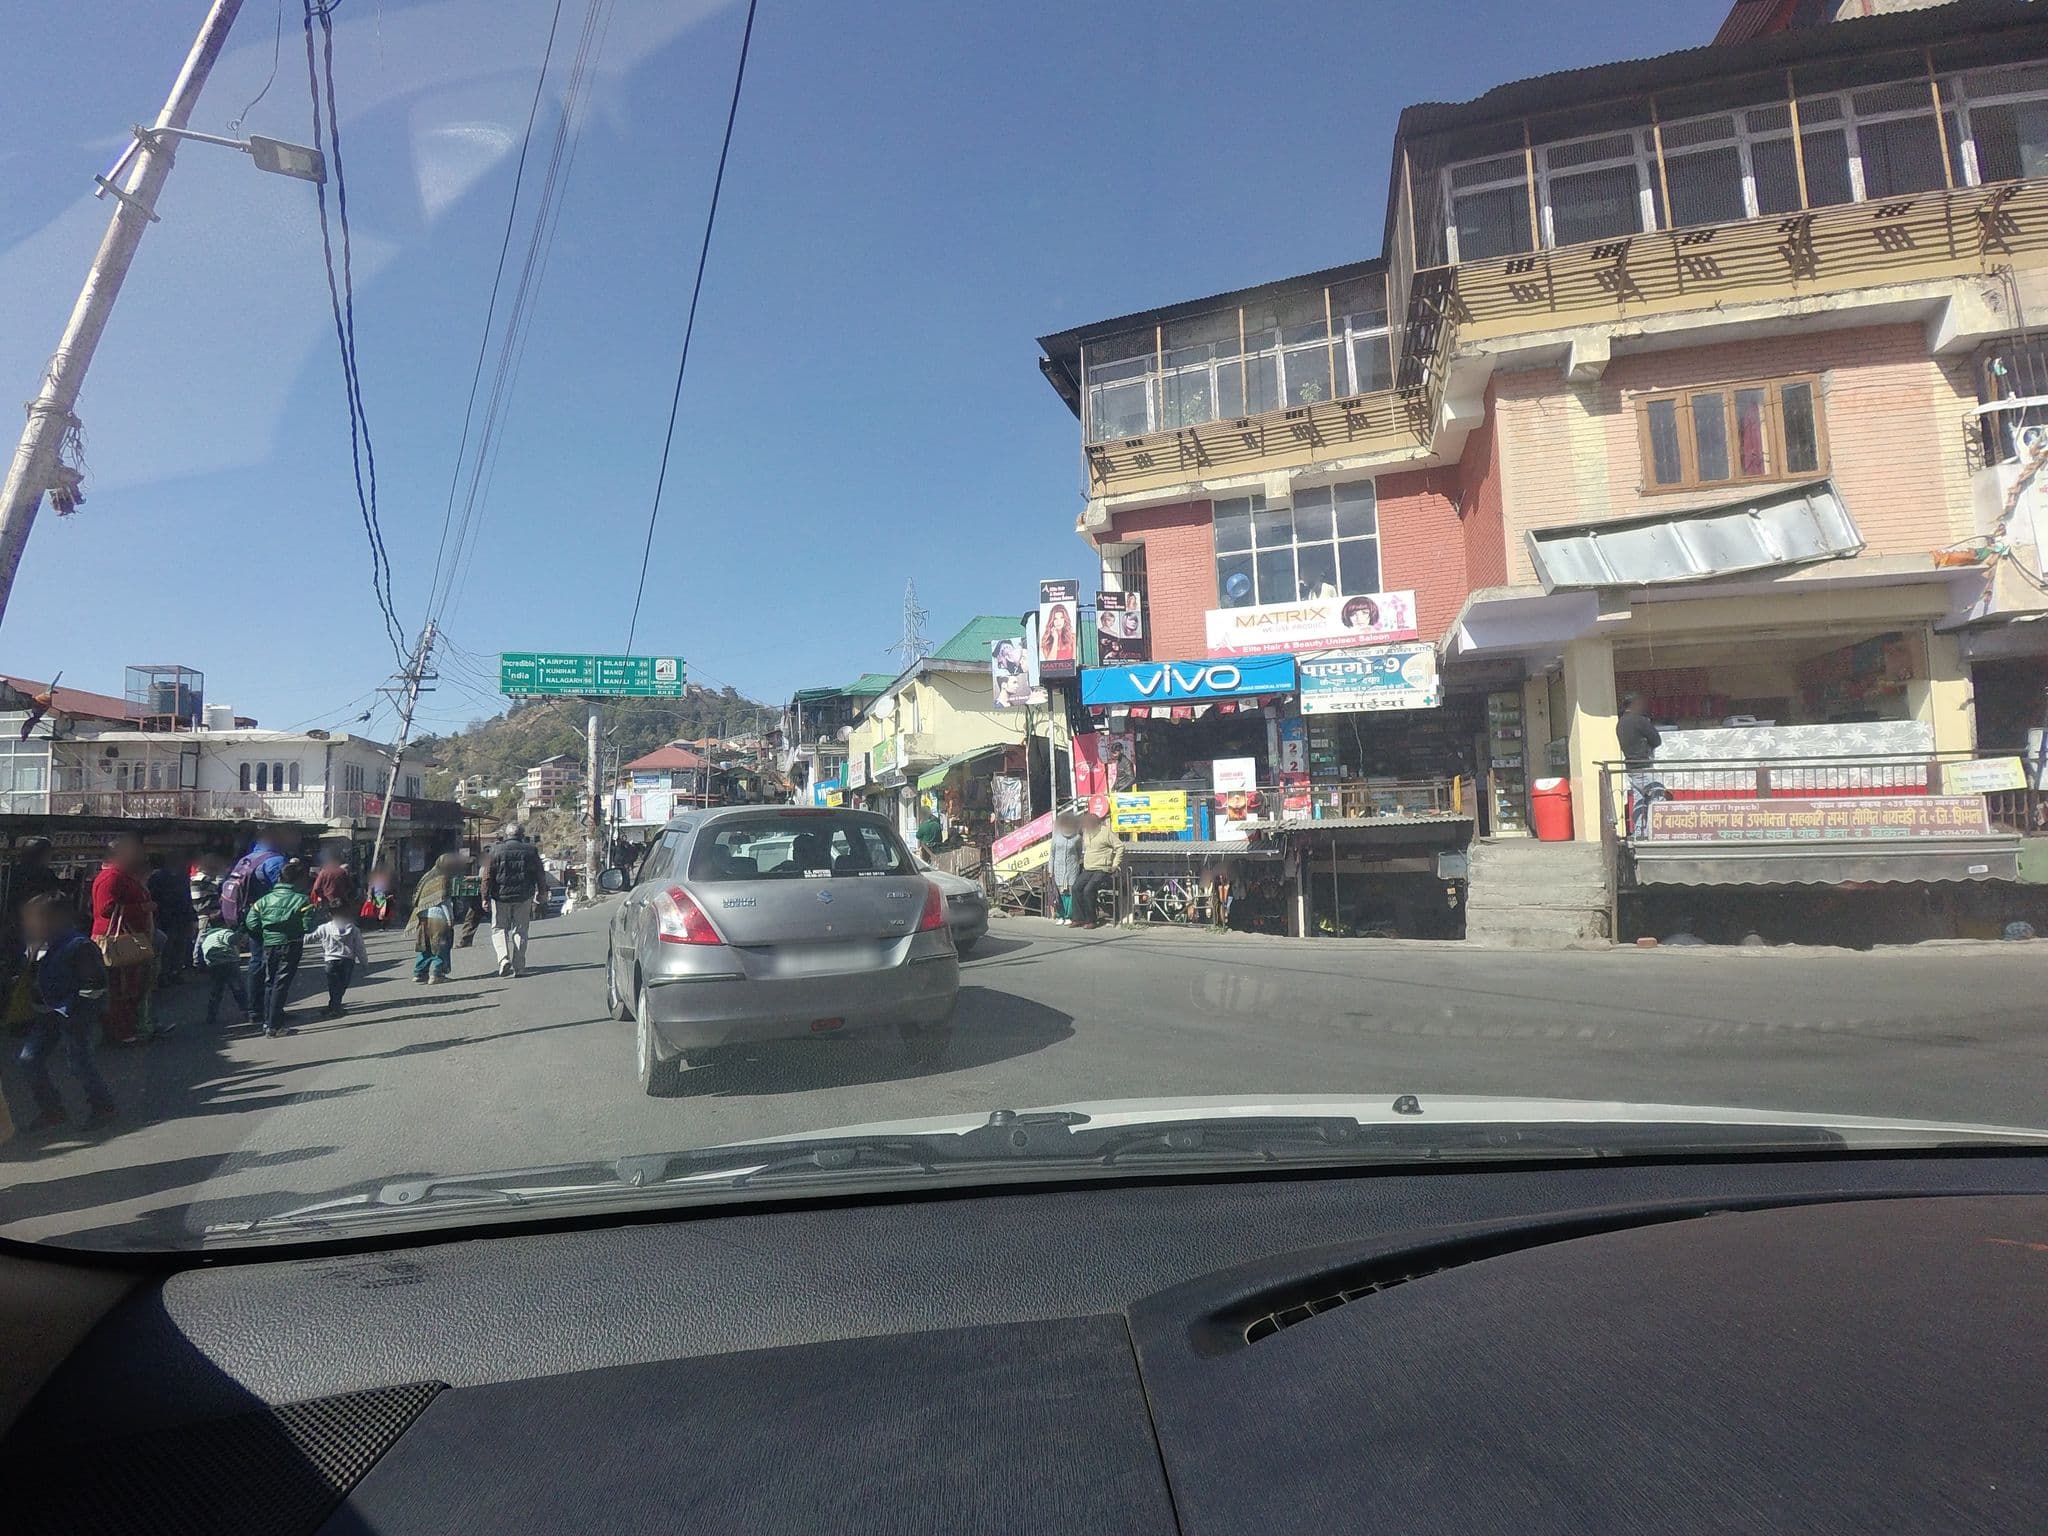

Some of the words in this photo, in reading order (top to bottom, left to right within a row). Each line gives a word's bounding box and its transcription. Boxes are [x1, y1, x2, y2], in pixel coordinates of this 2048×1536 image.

[1235, 607, 1327, 628] MATRIX
[1242, 645, 1261, 653] Elite
[1263, 642, 1281, 651] Hair
[1283, 642, 1291, 650] &
[1292, 639, 1324, 650] Beauty
[1325, 636, 1357, 646] Unisex
[1358, 632, 1390, 642] Saloon
[502, 659, 535, 667] Incredible
[508, 668, 530, 679] India
[1129, 664, 1242, 695] vivo
[1700, 811, 1729, 828] विपणन
[1747, 810, 1786, 828] उपभोक्ता
[1789, 809, 1825, 827] सहकारी
[1827, 810, 1848, 826] सभा
